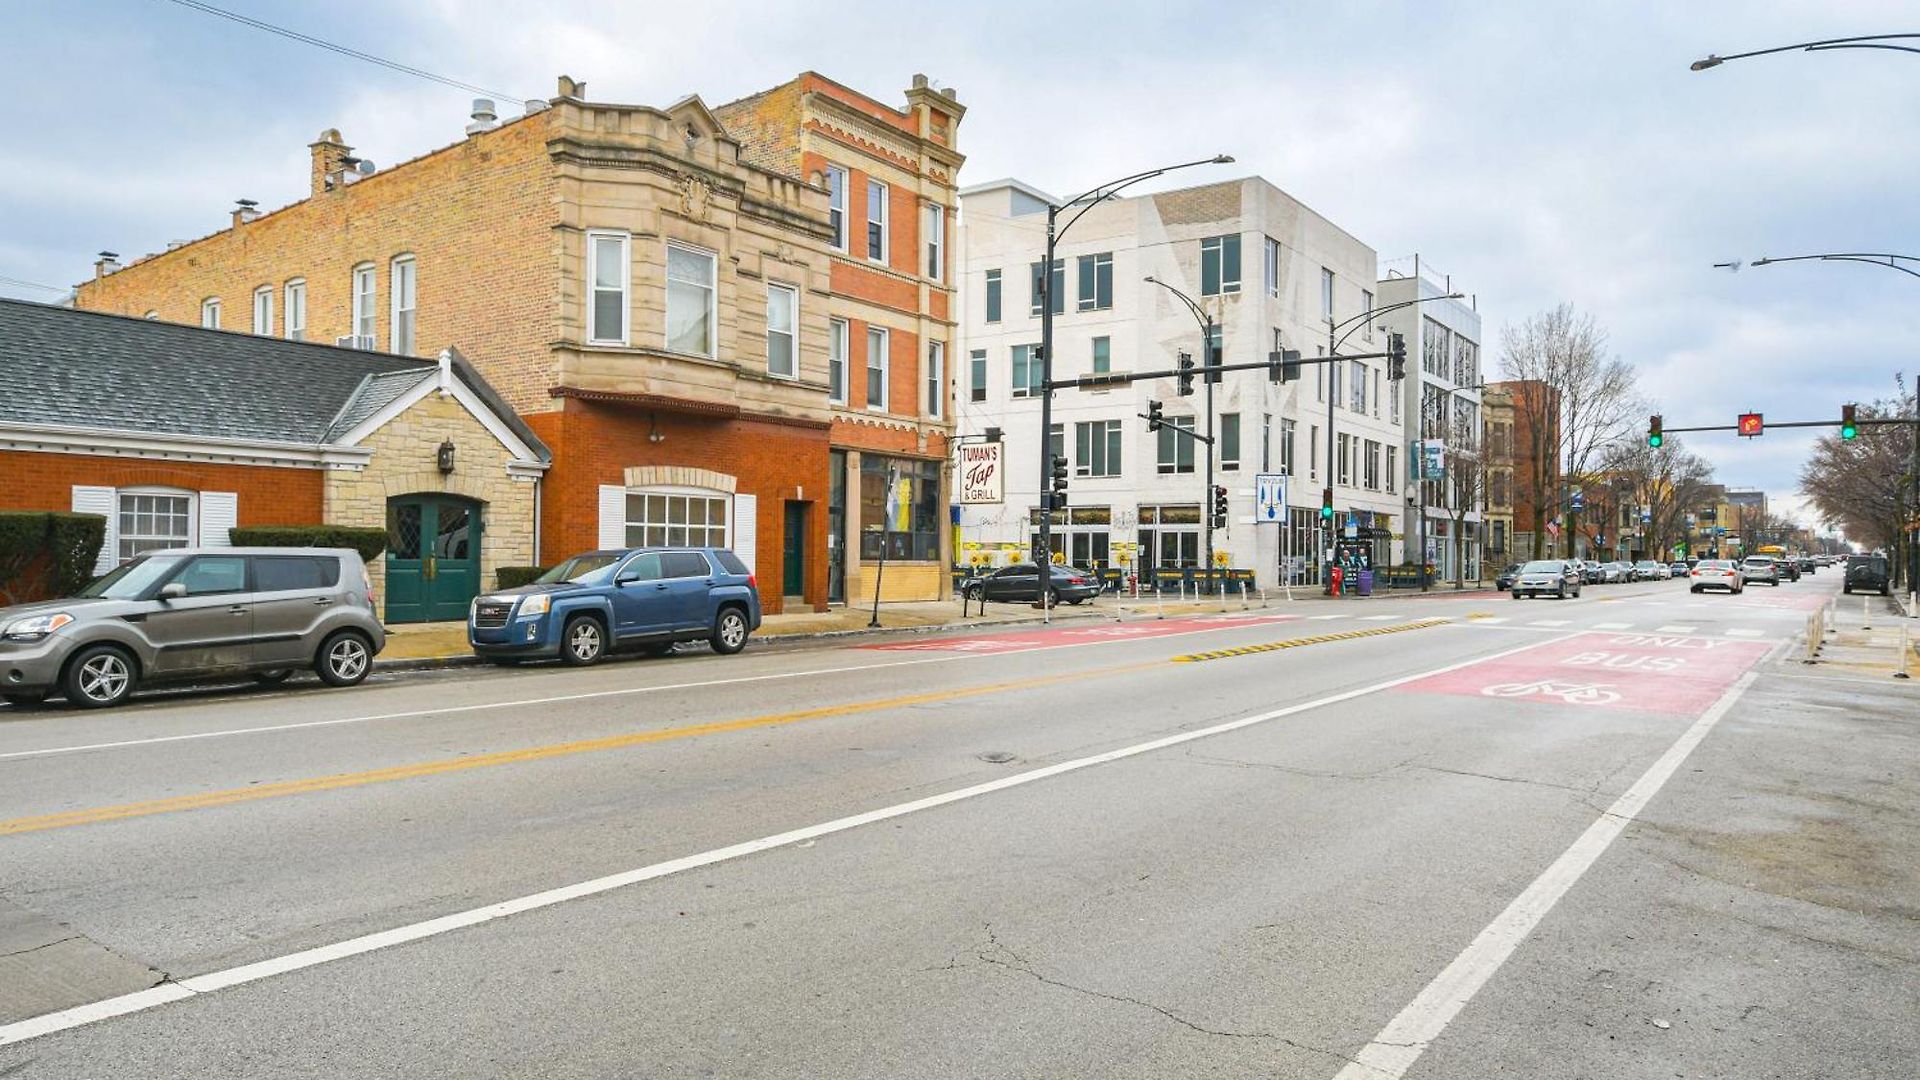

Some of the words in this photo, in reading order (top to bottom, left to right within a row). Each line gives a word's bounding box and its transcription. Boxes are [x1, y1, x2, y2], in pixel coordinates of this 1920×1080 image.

[963, 446, 997, 461] TUMAN'S
[965, 463, 994, 490] Tap
[971, 490, 996, 500] GRILL
[1608, 636, 1729, 650] ONLY
[1561, 652, 1686, 672] BUS
